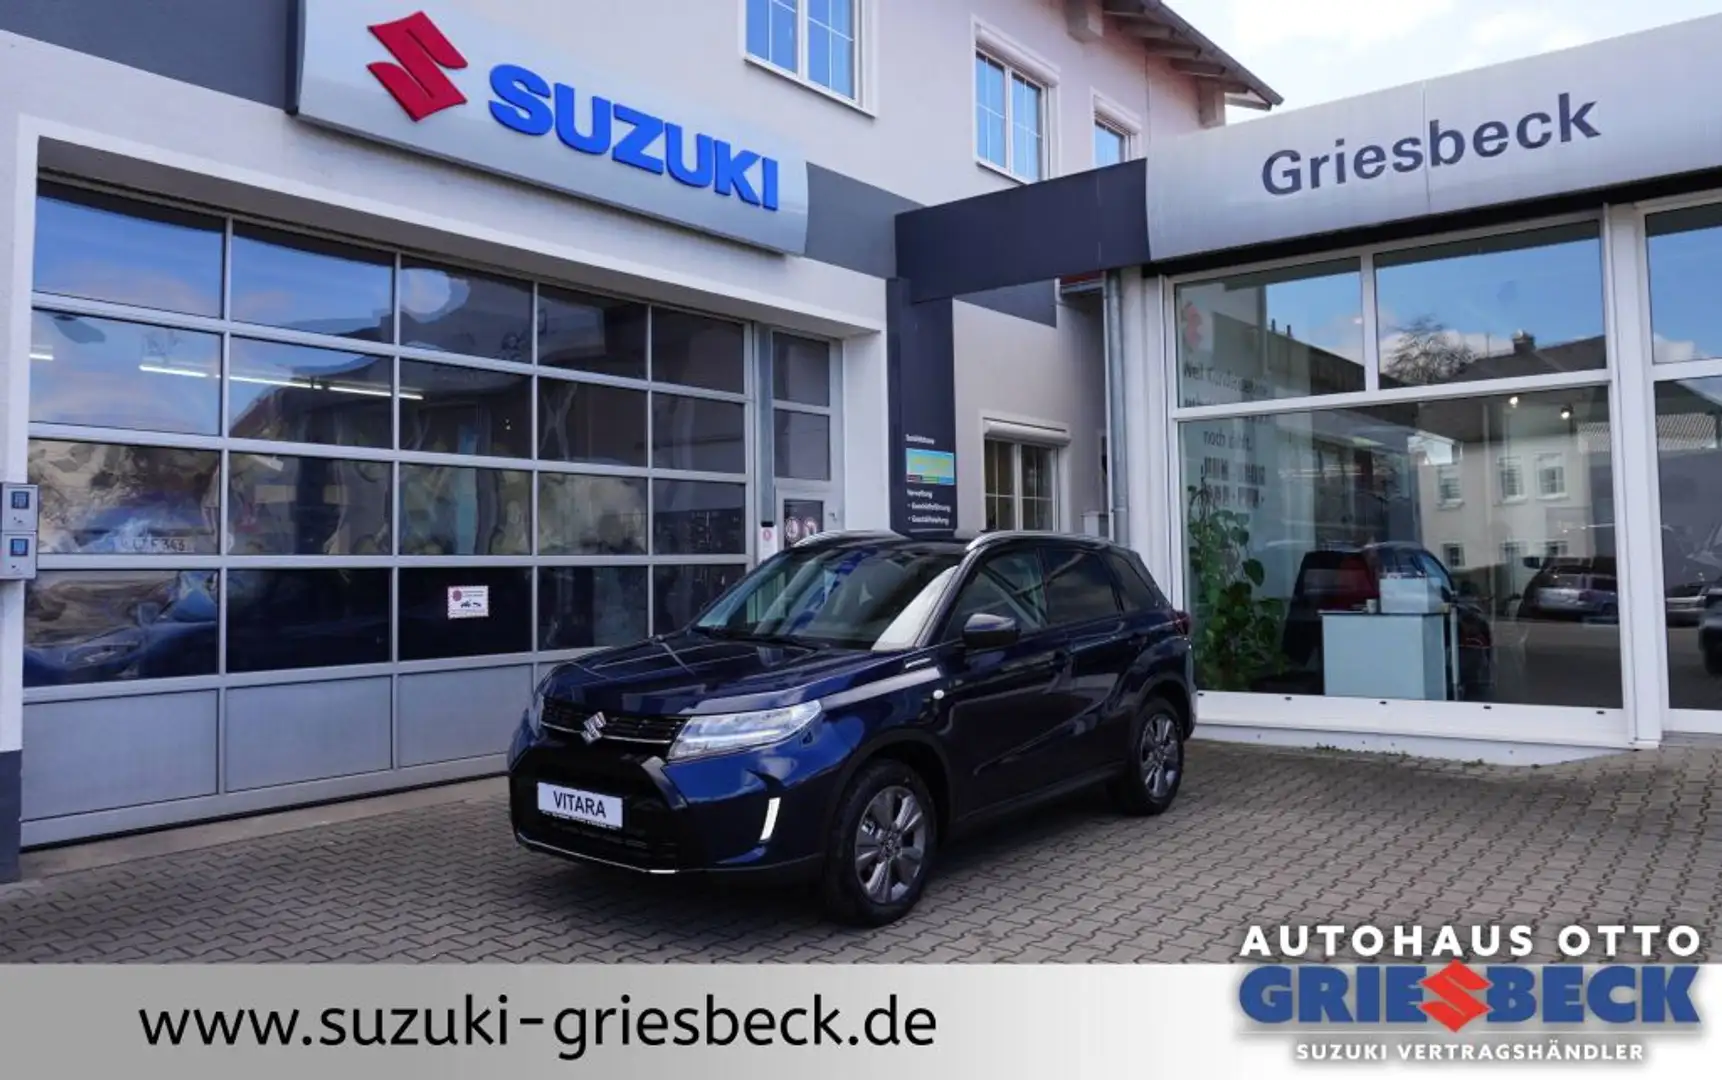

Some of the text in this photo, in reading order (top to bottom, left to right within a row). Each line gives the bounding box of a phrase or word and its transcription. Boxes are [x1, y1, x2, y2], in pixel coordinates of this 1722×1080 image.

[488, 64, 779, 211] SUZUKI
[1262, 92, 1602, 196] Griesbeck
[553, 790, 607, 819] VITARA
